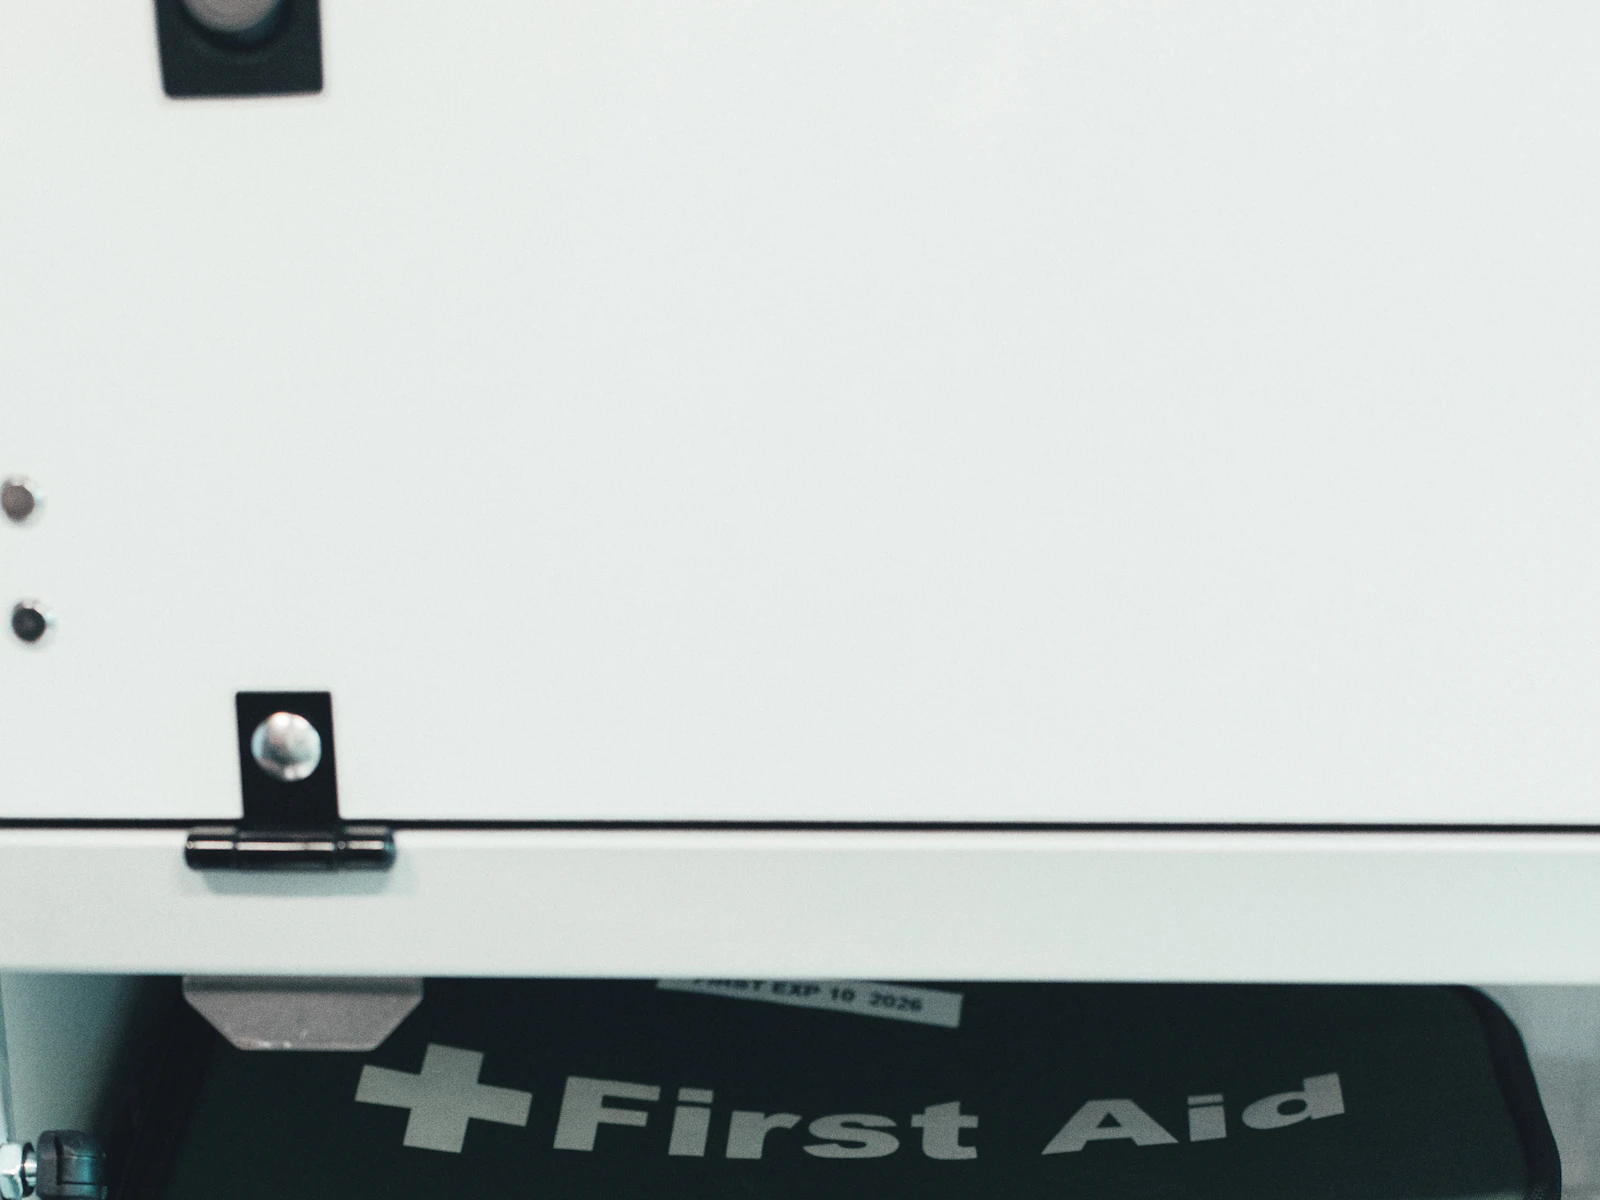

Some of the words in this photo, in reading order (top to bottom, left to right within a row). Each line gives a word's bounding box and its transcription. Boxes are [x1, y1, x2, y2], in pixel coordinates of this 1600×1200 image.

[772, 981, 820, 997] EXP
[830, 987, 856, 1003] 10
[869, 991, 923, 1013] 2026
[553, 1076, 978, 1160] First
[1041, 1072, 1345, 1155] Aid
